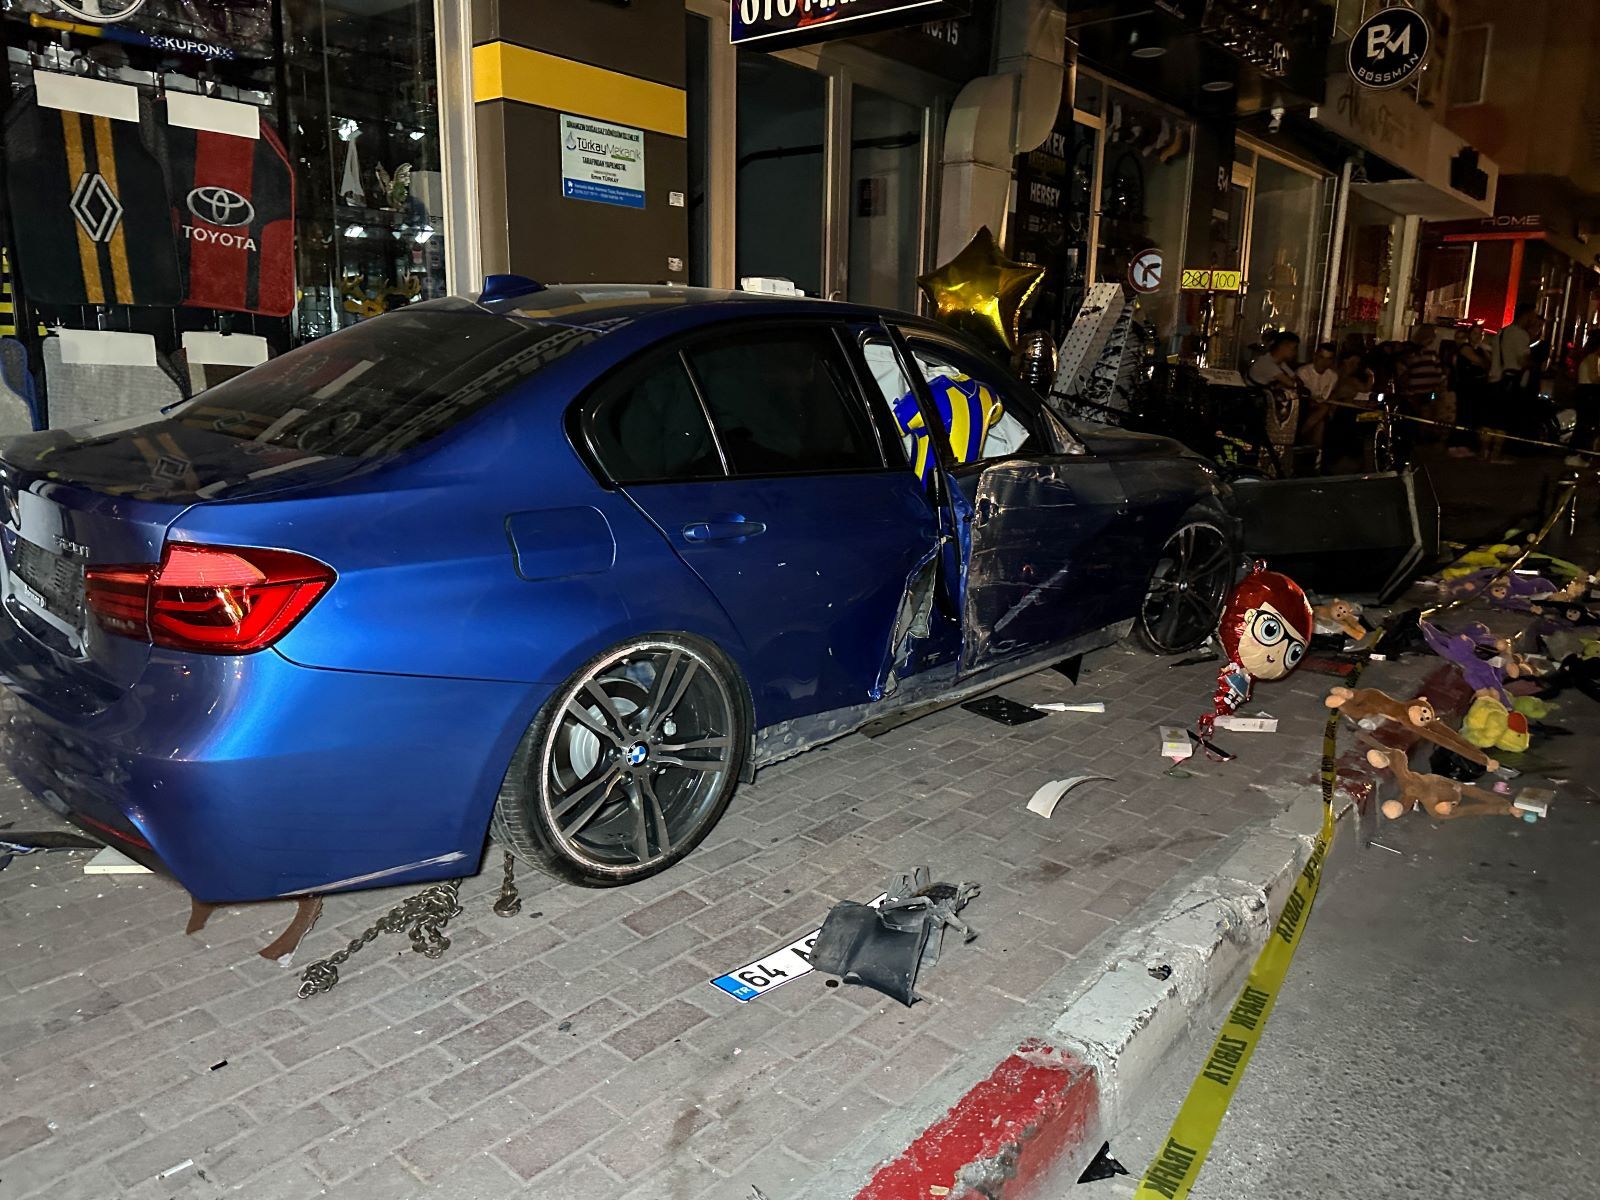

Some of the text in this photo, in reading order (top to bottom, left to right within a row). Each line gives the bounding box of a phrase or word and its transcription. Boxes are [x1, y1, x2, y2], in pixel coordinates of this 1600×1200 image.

[164, 37, 220, 55] KUPON
[1480, 214, 1541, 227] HOME
[182, 225, 257, 252] TOYOTA
[1214, 272, 1236, 288] 100
[738, 964, 789, 988] 64
[732, 986, 753, 997] TR
